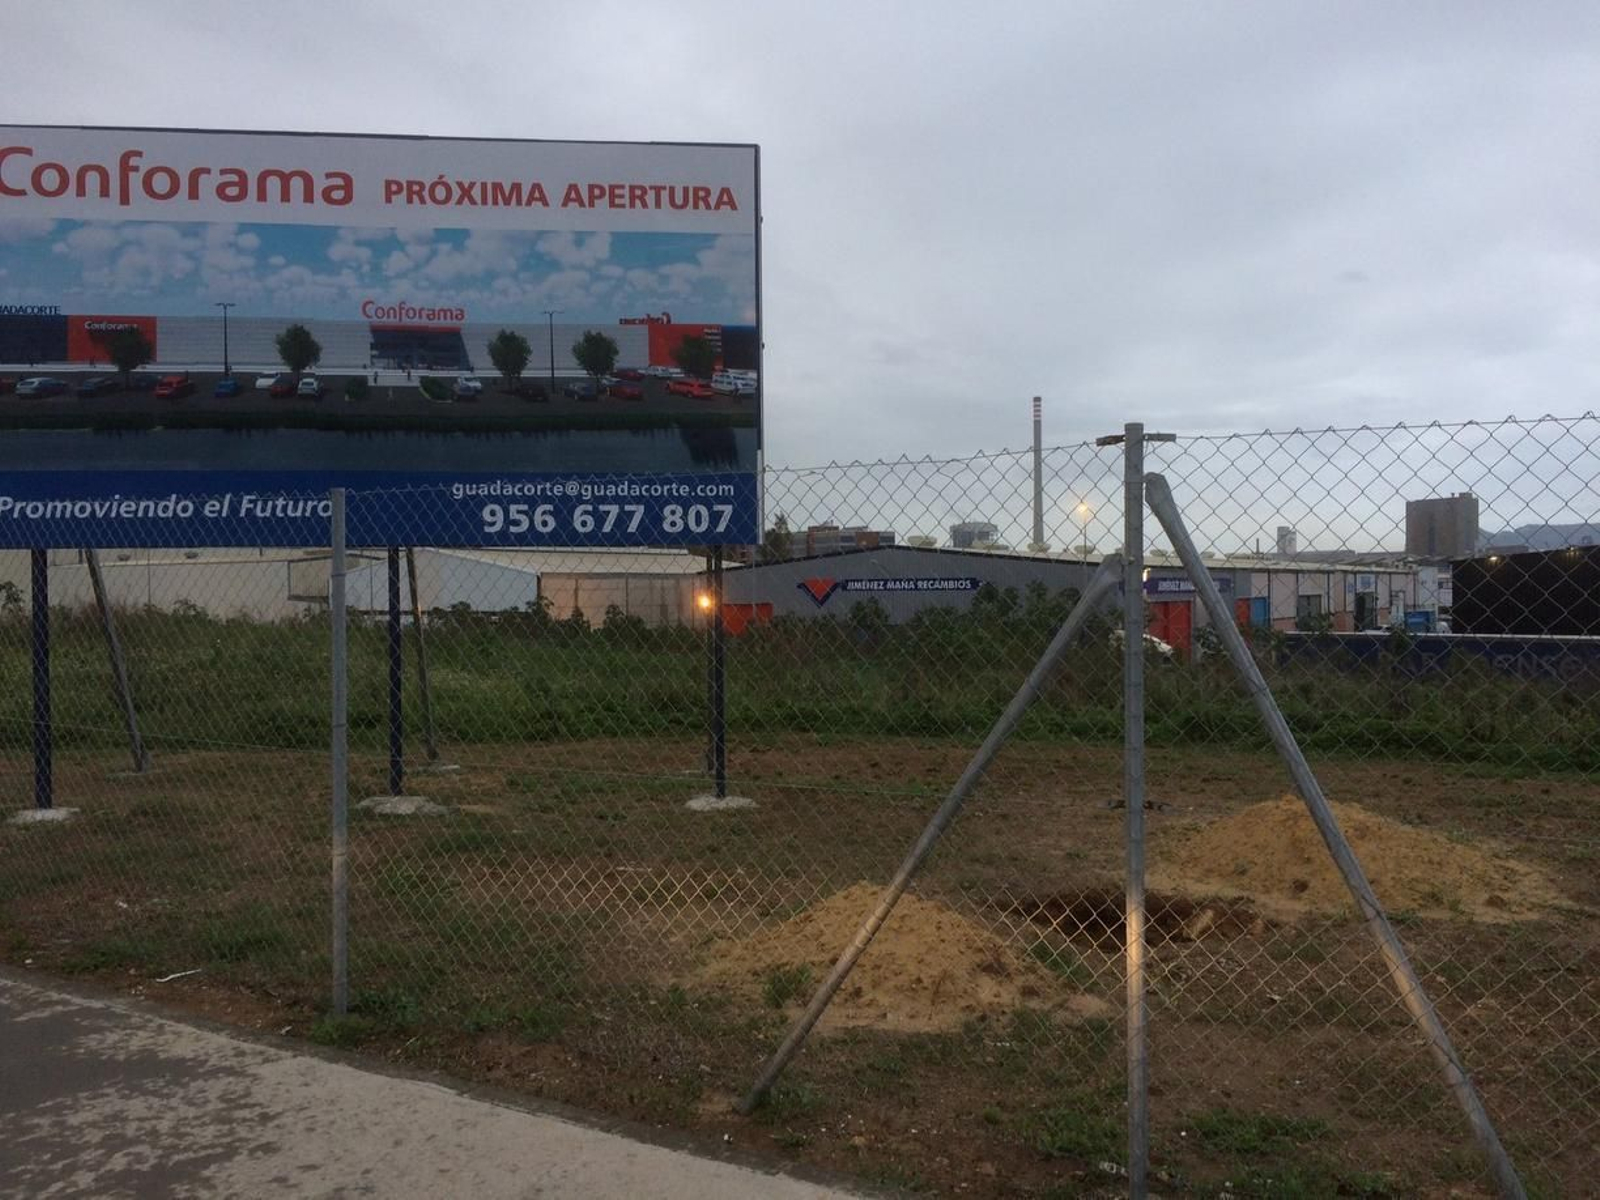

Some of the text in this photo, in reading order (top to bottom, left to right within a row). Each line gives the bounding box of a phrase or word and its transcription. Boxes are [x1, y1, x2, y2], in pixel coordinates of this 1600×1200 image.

[0, 146, 354, 207] Conforama
[383, 175, 738, 211] PRÓXIMA APERTURA
[0, 304, 61, 315] ADACORTE
[362, 299, 465, 322] Conforama
[452, 481, 735, 499] guadacorte@guadacorte.com
[0, 494, 332, 518] Promoviendo el Futuro
[482, 504, 733, 534] 956 677 807
[917, 579, 971, 589] RECAMBIOS
